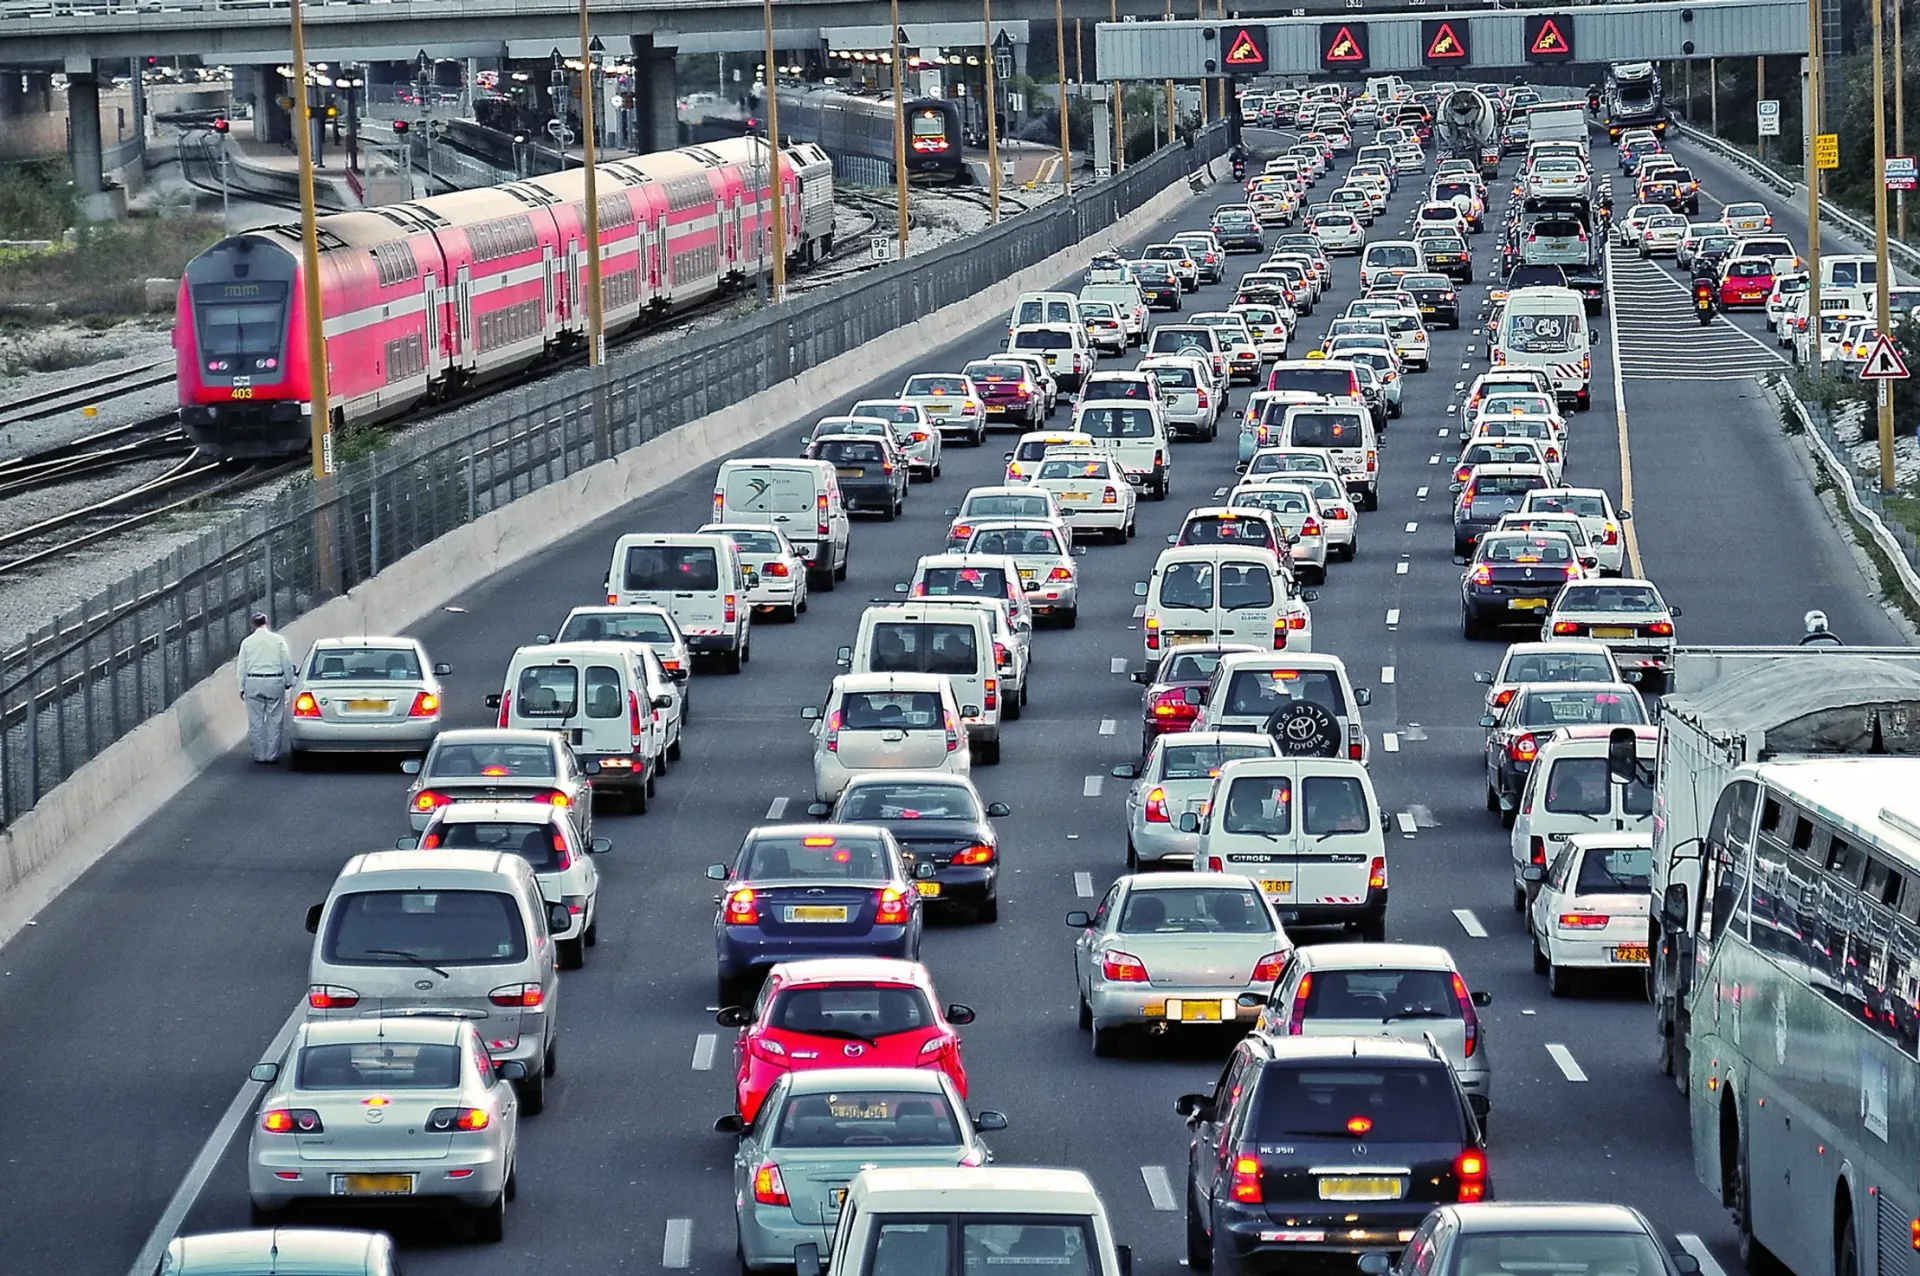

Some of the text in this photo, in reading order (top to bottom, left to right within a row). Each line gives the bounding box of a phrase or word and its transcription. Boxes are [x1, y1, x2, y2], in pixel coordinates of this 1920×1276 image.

[873, 239, 888, 248] 92
[877, 248, 885, 258] 8
[231, 388, 253, 399] 403
[1296, 706, 1329, 727] חדרה
[1288, 733, 1324, 750] TOYOTA
